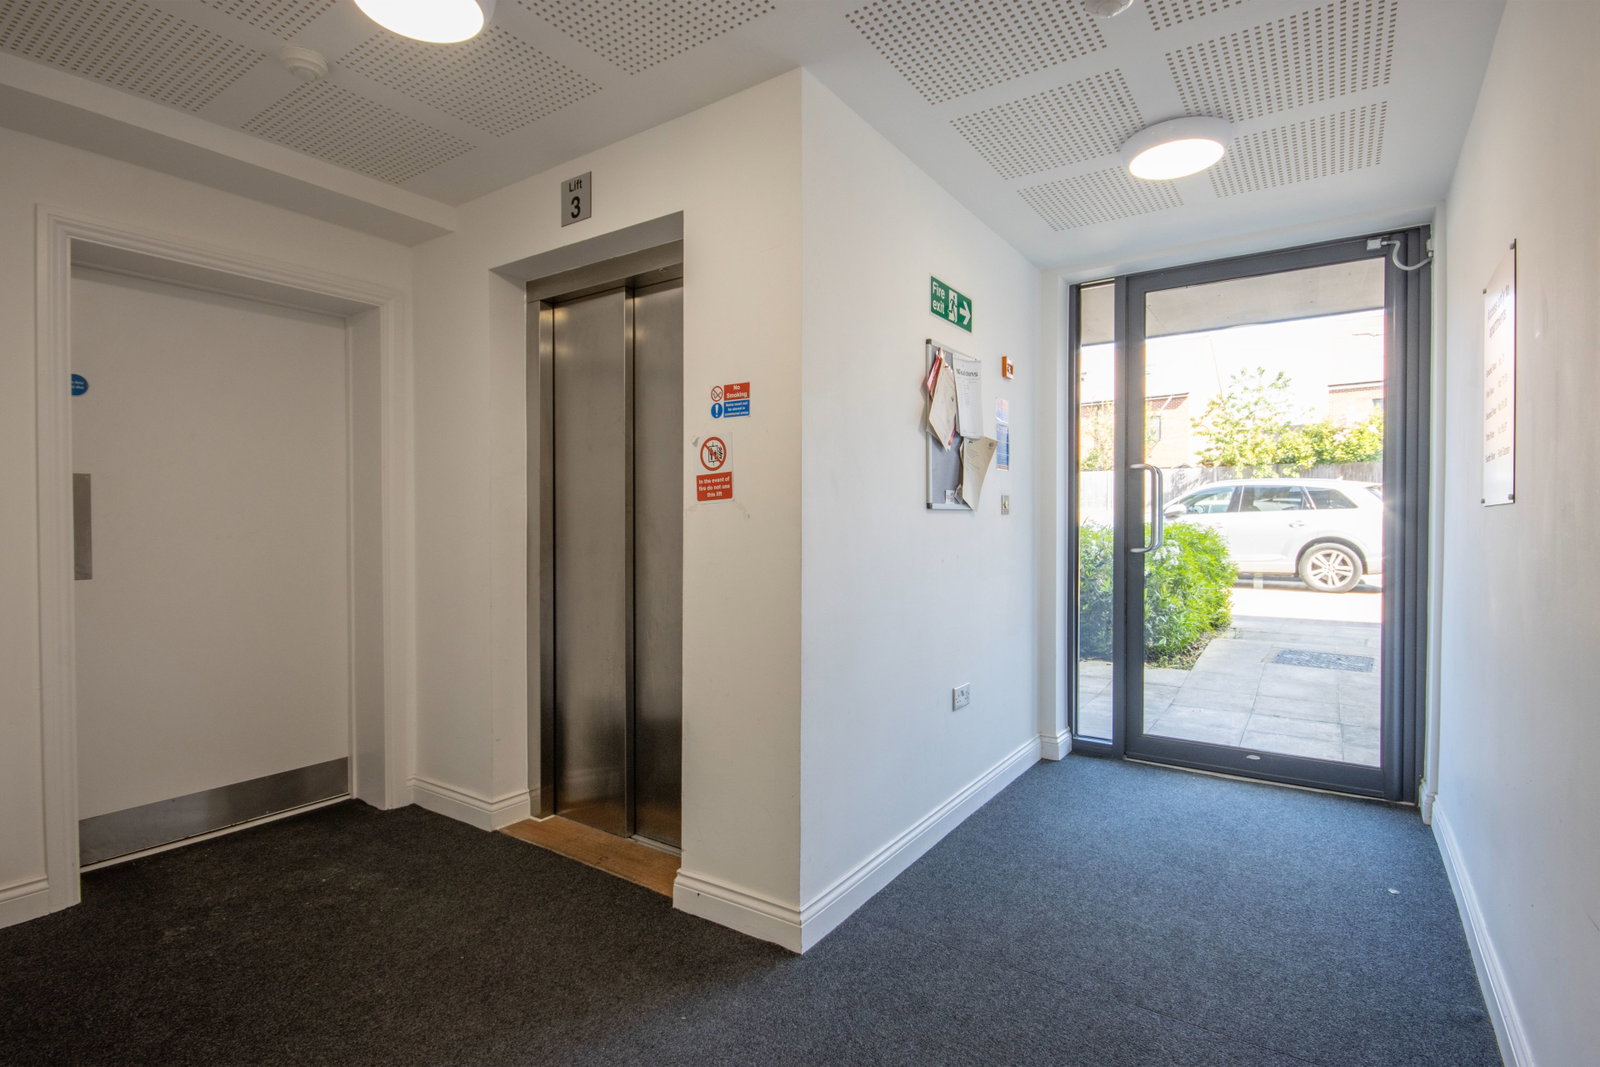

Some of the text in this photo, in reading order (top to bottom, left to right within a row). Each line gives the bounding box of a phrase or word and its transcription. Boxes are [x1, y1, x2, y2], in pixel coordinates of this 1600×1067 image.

[569, 179, 582, 192] Lift
[571, 196, 581, 219] 3
[932, 281, 946, 300] Fire
[932, 299, 945, 315] exit
